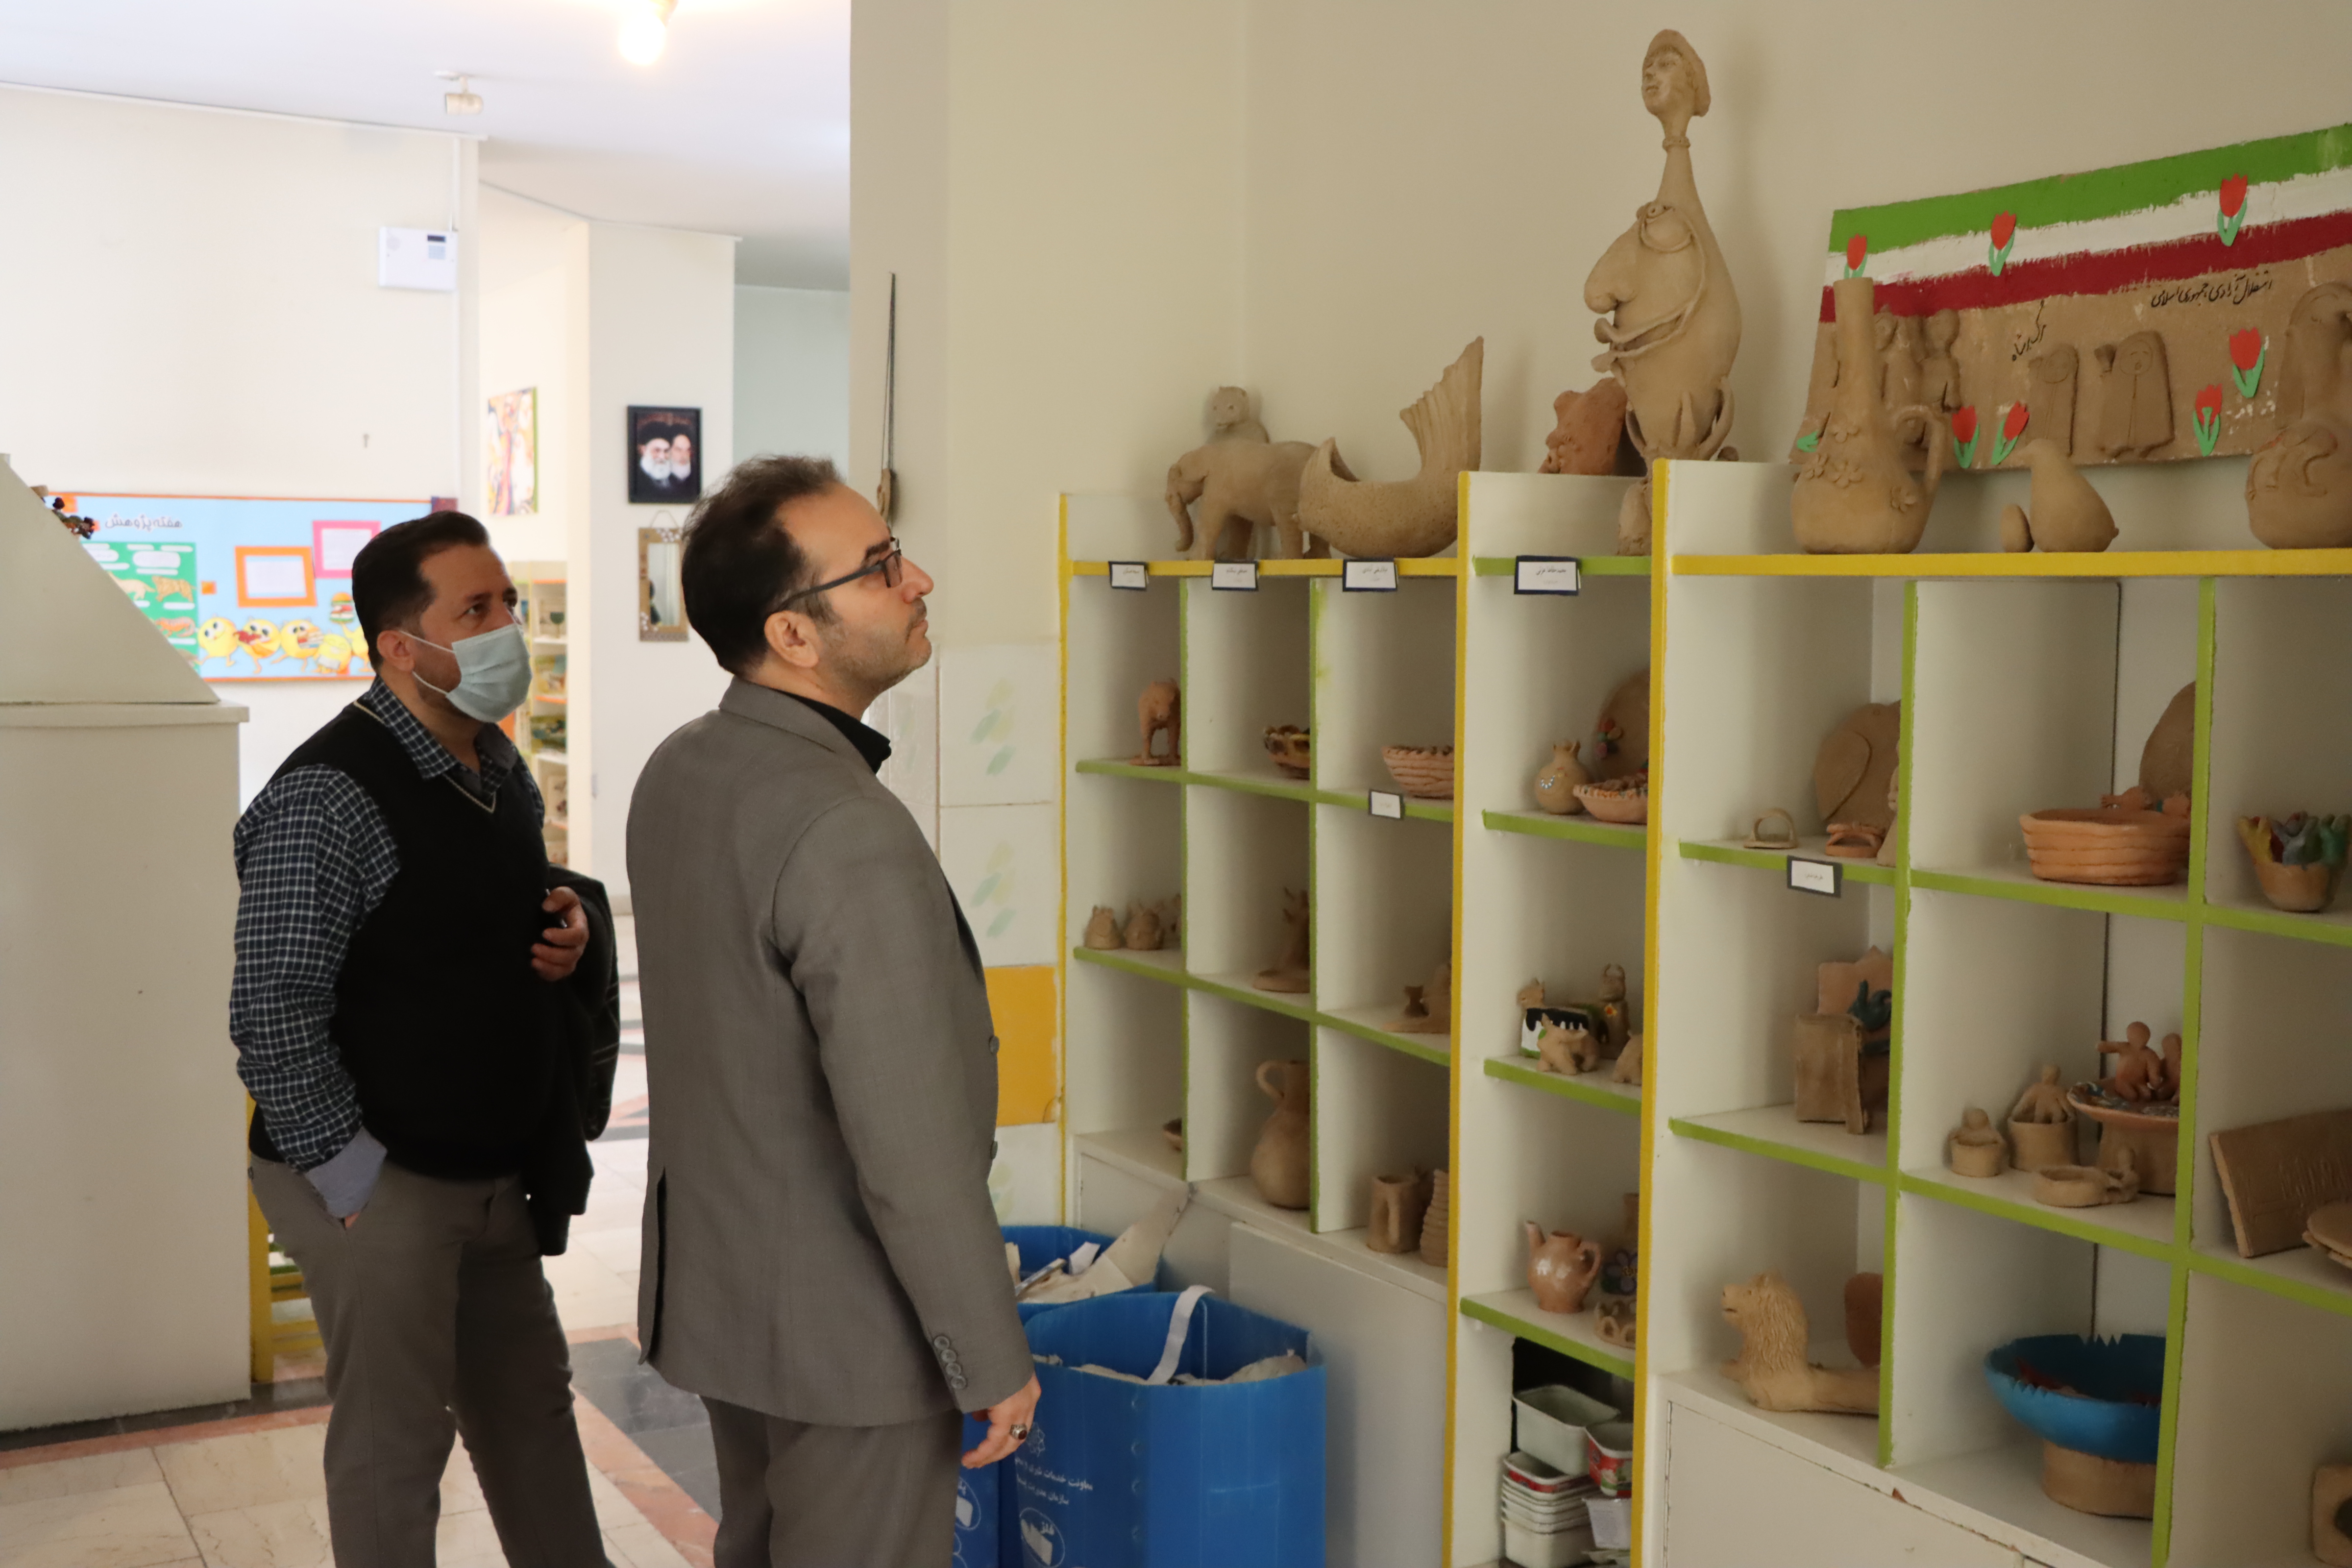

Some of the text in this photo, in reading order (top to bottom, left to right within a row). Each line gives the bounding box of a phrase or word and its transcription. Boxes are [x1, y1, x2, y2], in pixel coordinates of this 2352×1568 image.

[2178, 282, 2209, 307] جمهوری
[2233, 270, 2273, 305] استقلال
[2151, 286, 2180, 308] اسلامی
[105, 513, 183, 533] هفته پژوهش
[1043, 1470, 1067, 1483] خدمات
[1068, 1478, 1094, 1491] معاونت
[1048, 1491, 1070, 1505] سازمان
[1041, 1521, 1055, 1536] فلز
